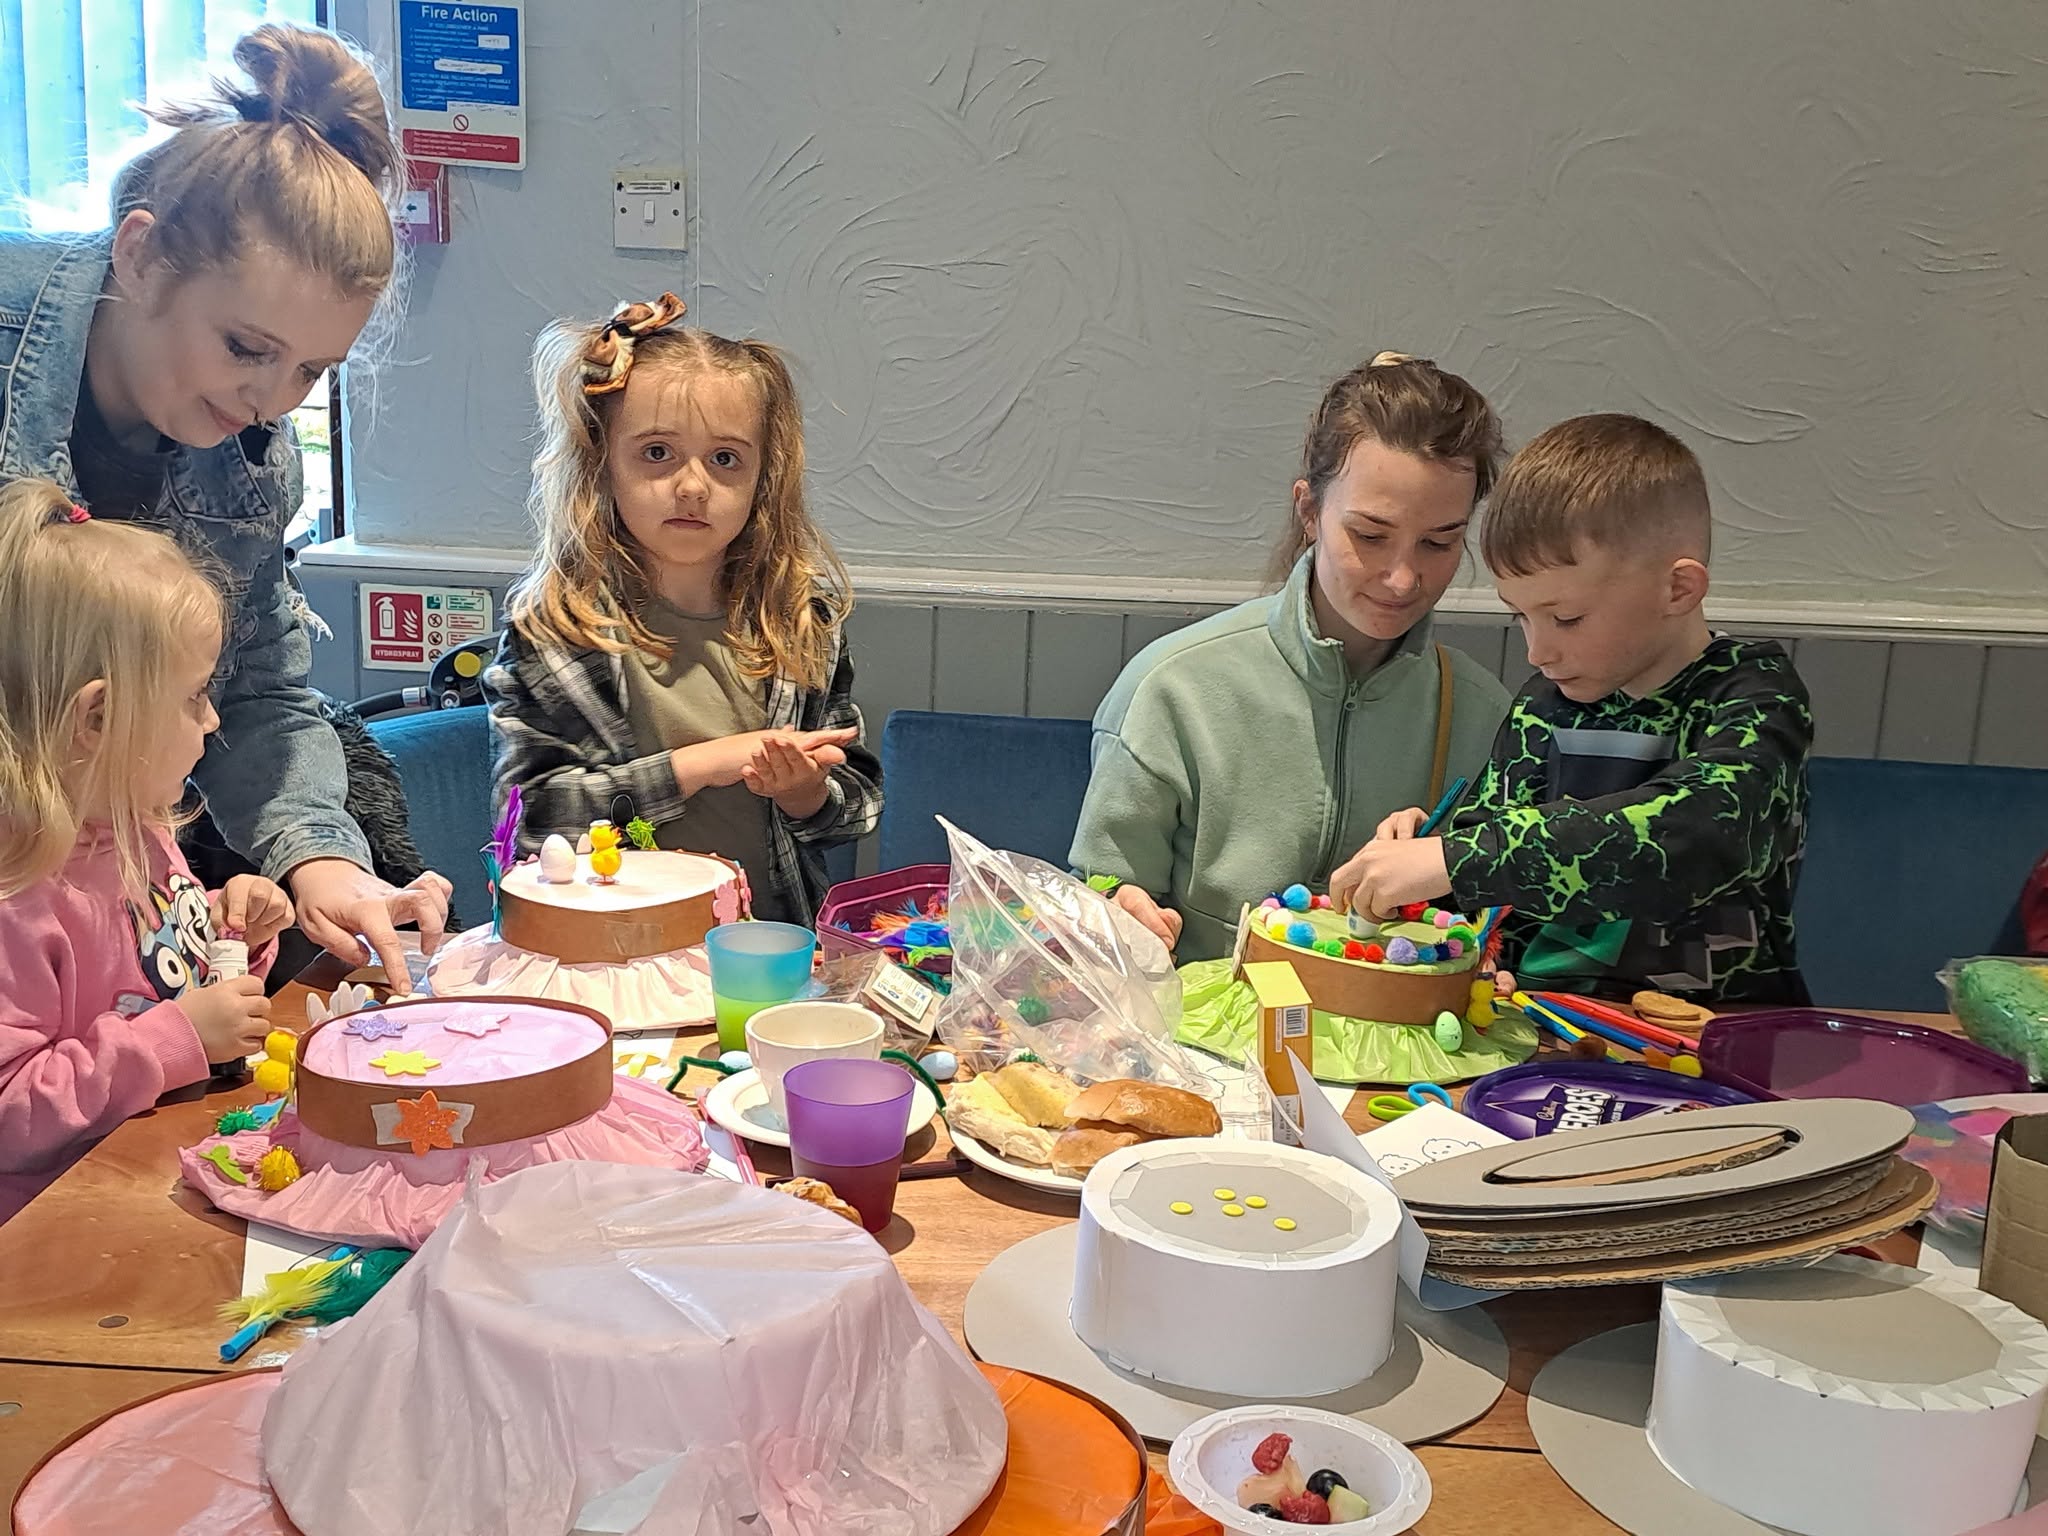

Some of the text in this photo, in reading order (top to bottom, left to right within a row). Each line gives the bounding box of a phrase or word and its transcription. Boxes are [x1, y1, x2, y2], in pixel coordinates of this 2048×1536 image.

[421, 5, 498, 23] Fire Action
[1552, 1087, 1614, 1133] EROES
